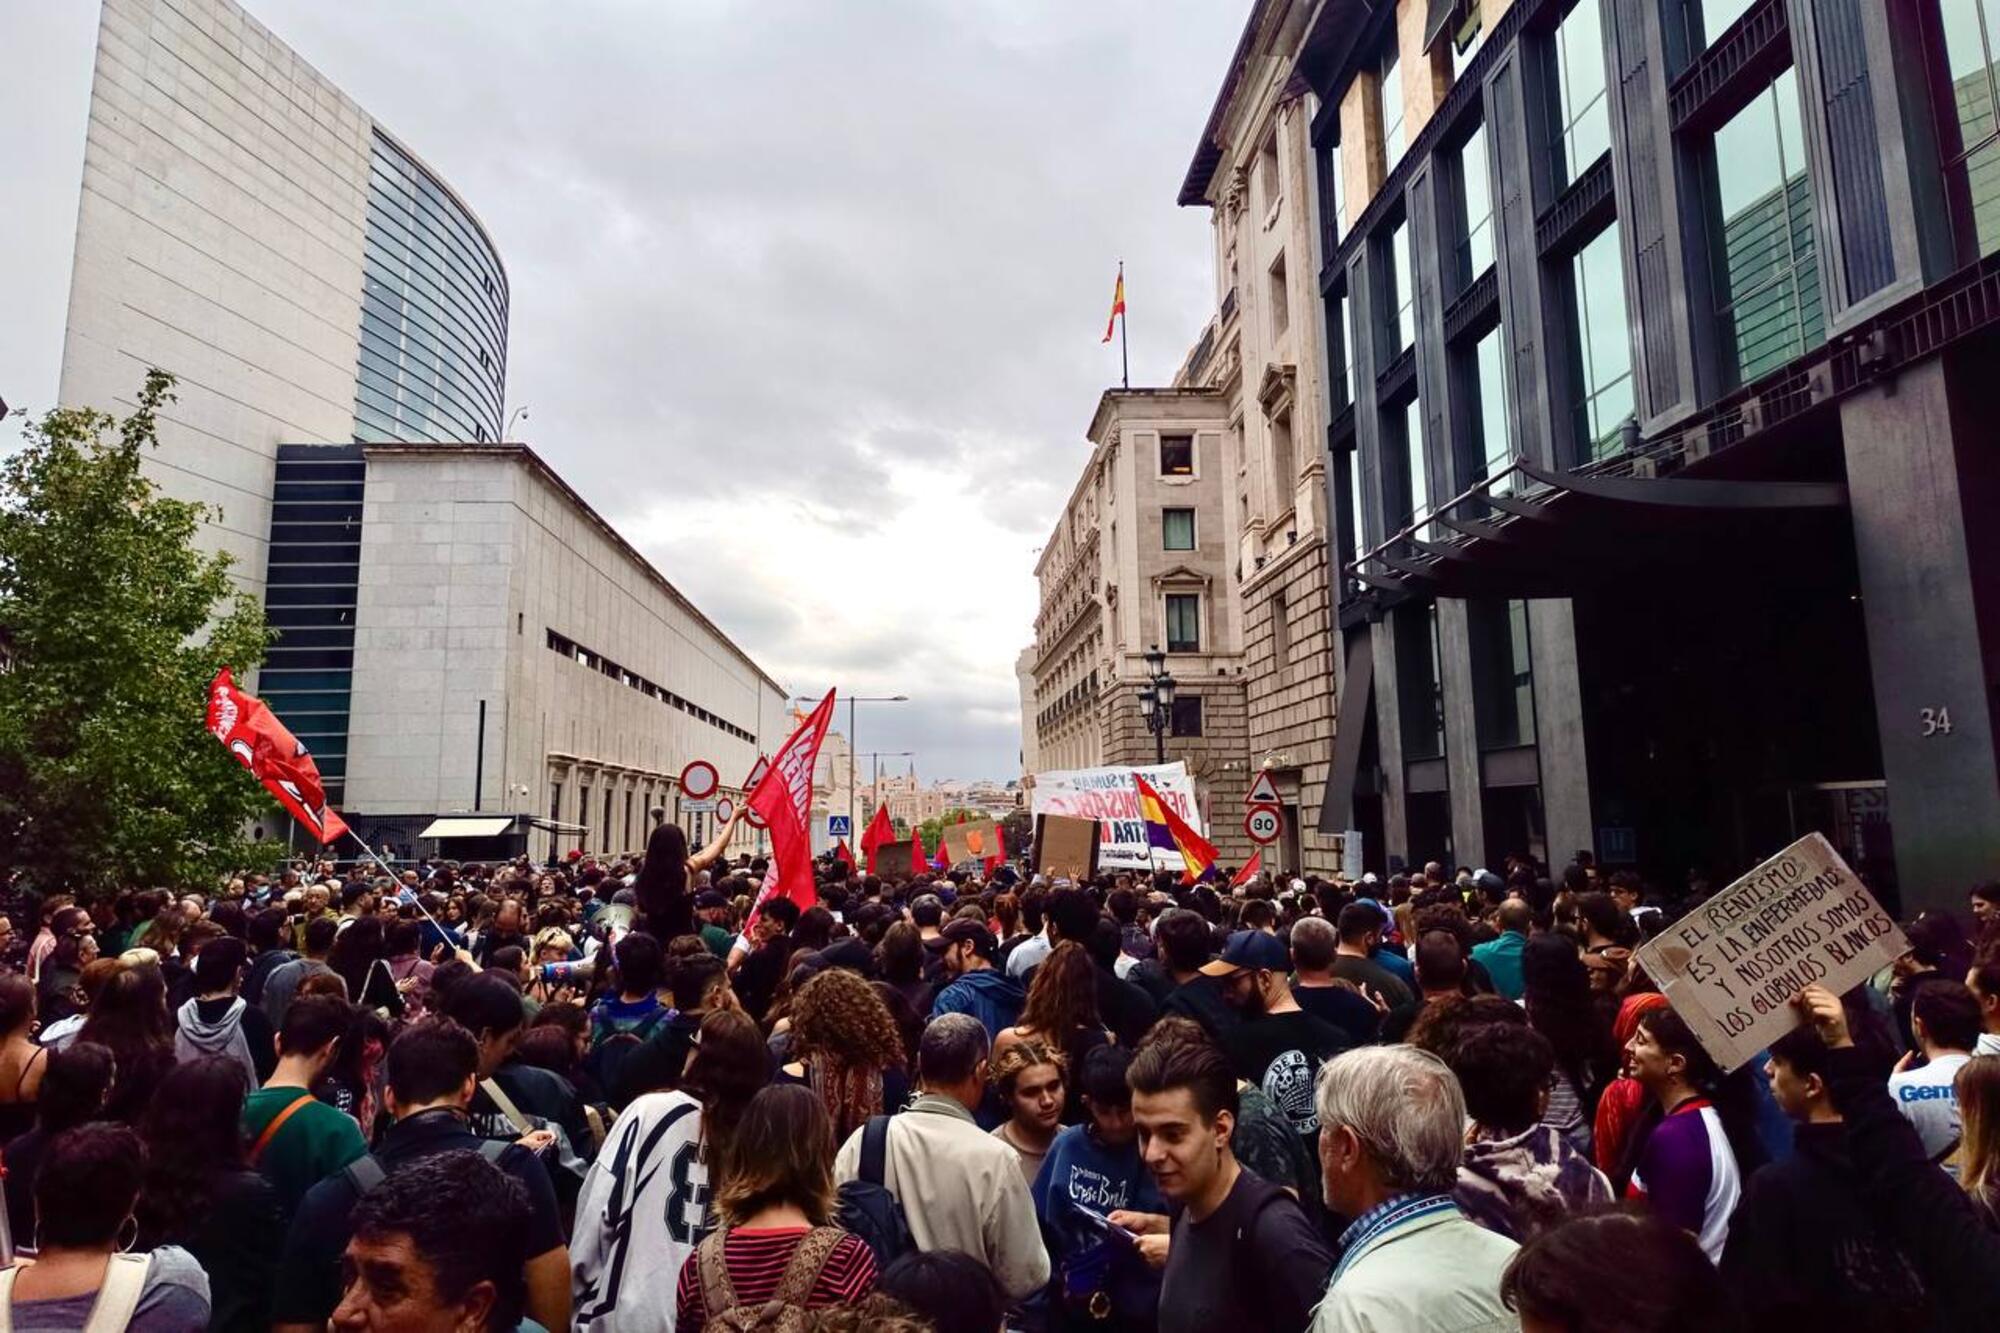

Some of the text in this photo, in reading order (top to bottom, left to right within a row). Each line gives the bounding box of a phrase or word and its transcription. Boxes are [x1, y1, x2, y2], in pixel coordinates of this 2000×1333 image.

[1920, 707, 1951, 736] 34
[1254, 818, 1274, 831] 30
[1679, 861, 1797, 948] EL RENTISMO
[1686, 871, 1840, 984] ES LA ENFERMEDAD
[1715, 891, 1870, 999] Y NOSOTROS SOMOS
[1716, 1006, 1754, 1038] LOS
[1823, 912, 1892, 965] BLANCOS
[1899, 1085, 1957, 1103] Gem
